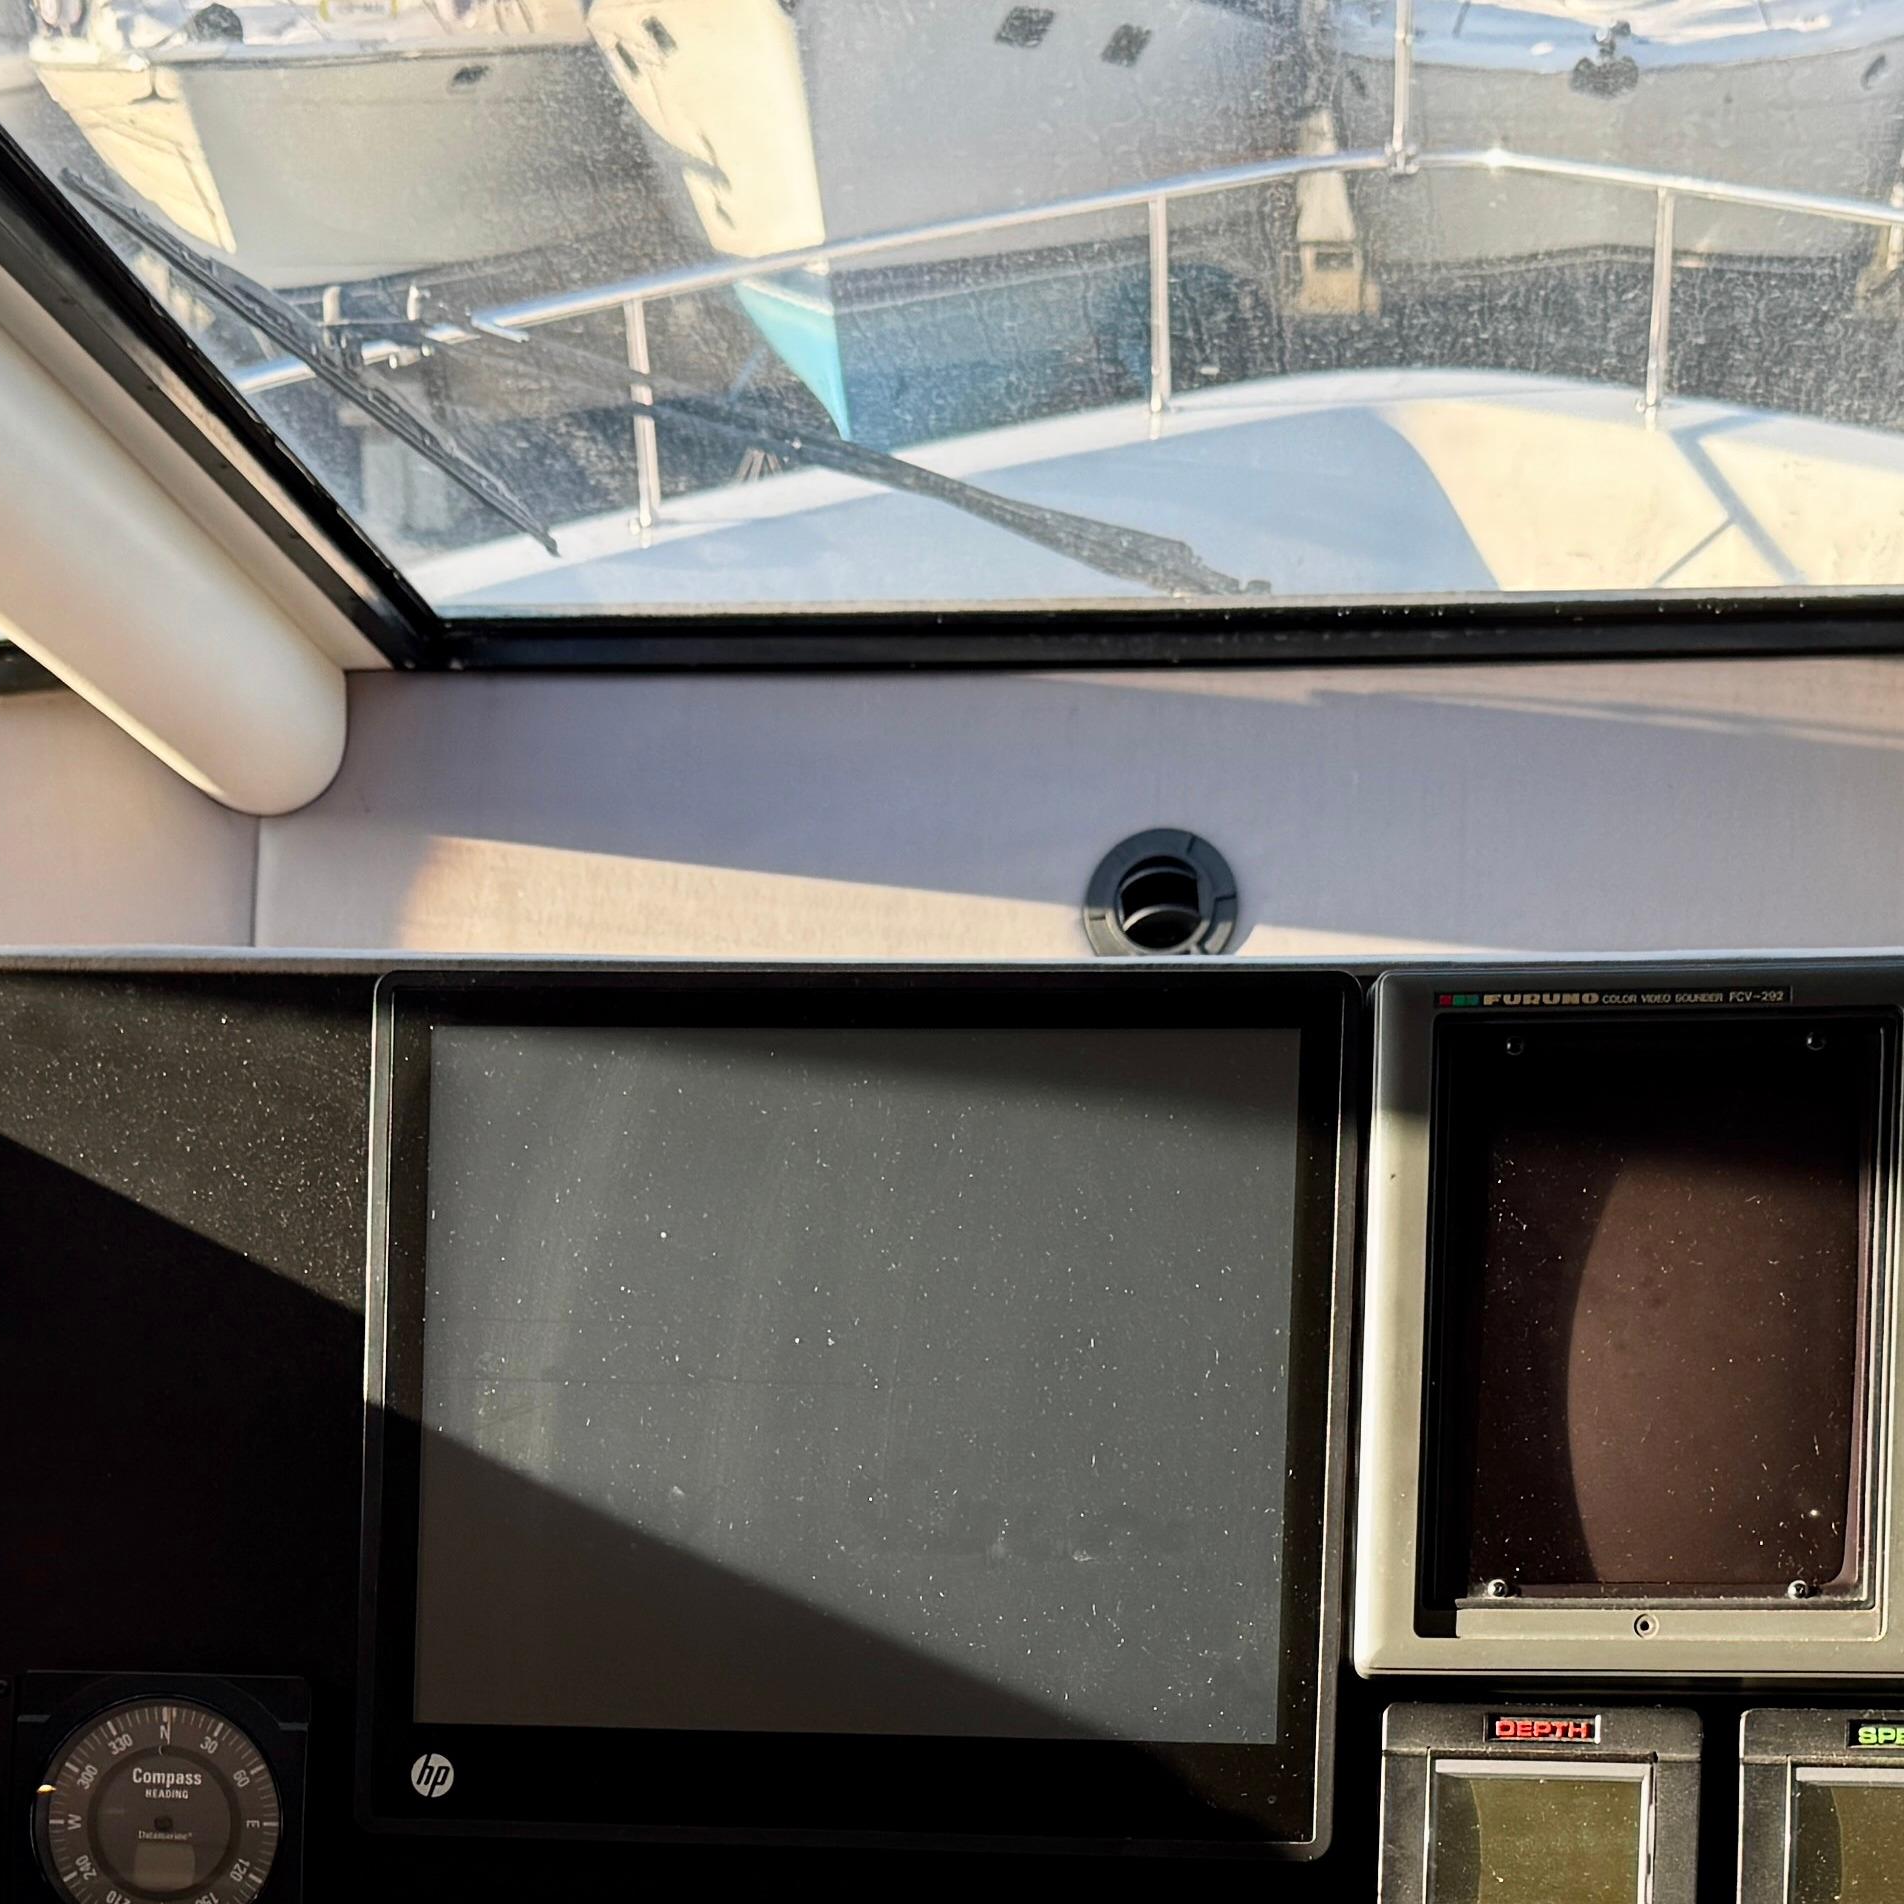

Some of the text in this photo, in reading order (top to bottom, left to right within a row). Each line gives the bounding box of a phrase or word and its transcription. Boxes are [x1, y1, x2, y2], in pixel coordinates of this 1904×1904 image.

[1483, 993, 1599, 1006] FURUNO
[1602, 995, 1637, 1005] COLOR
[159, 1725, 171, 1741] N
[1496, 1718, 1591, 1740] DEPTH
[107, 1733, 133, 1756] 330
[200, 1736, 219, 1755] 30
[76, 1764, 99, 1790] 300
[132, 1767, 203, 1789] Compass
[233, 1768, 250, 1789] 60
[414, 1753, 452, 1797] hp
[145, 1788, 189, 1800] HEADING
[67, 1813, 83, 1831] W
[246, 1818, 261, 1829] E
[75, 1854, 98, 1881] 240
[230, 1857, 251, 1883] 120
